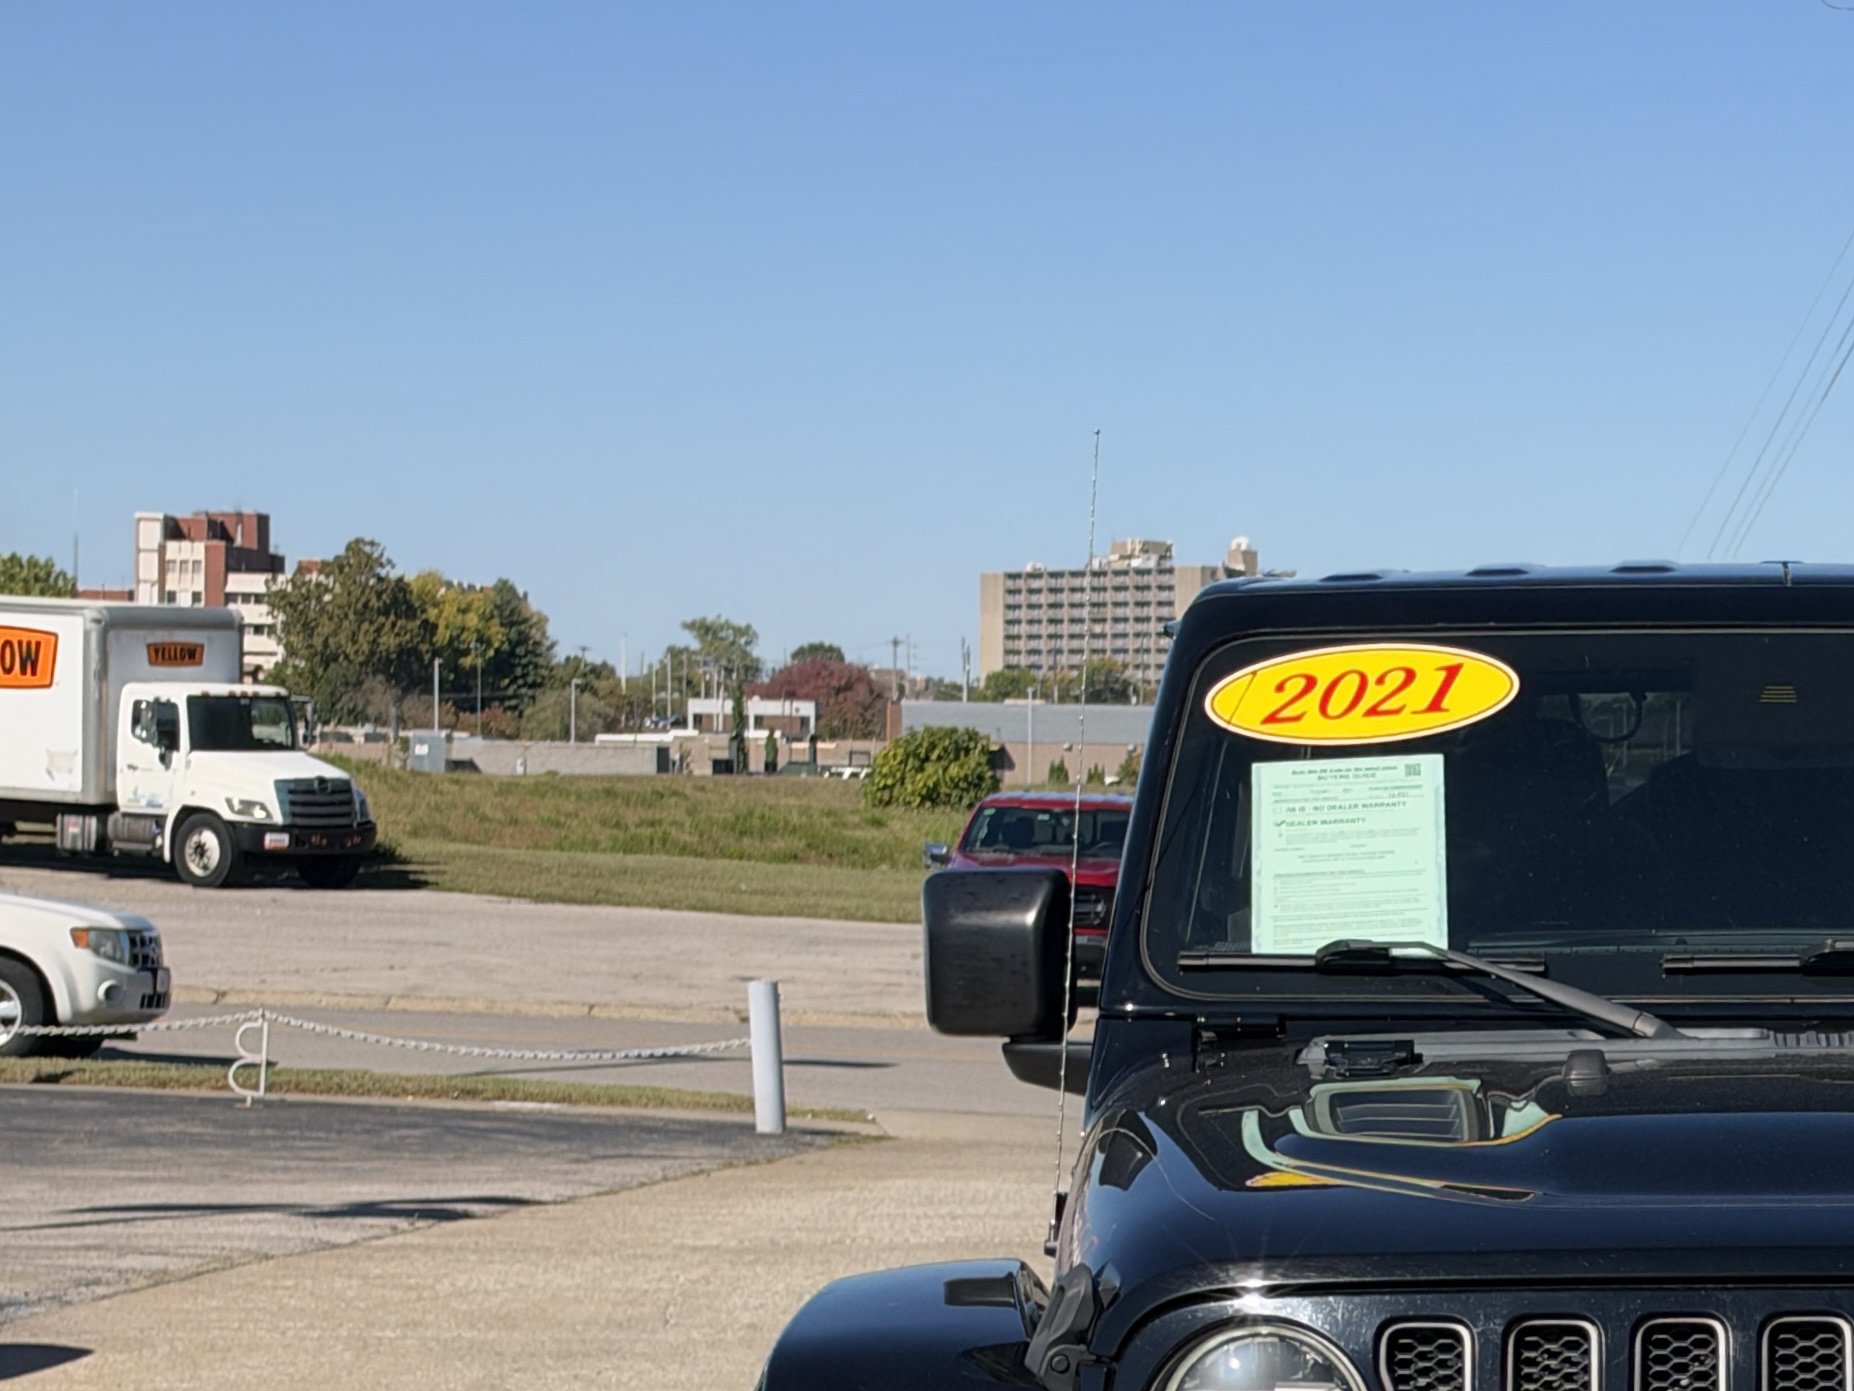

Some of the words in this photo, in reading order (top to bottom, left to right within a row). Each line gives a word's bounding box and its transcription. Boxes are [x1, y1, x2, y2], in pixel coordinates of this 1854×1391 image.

[154, 645, 197, 661] YELLOW
[1260, 662, 1464, 725] 2021
[1361, 801, 1407, 809] WARRANTY
[1286, 819, 1318, 827] DEALER
[1320, 817, 1366, 825] WARRANTY
